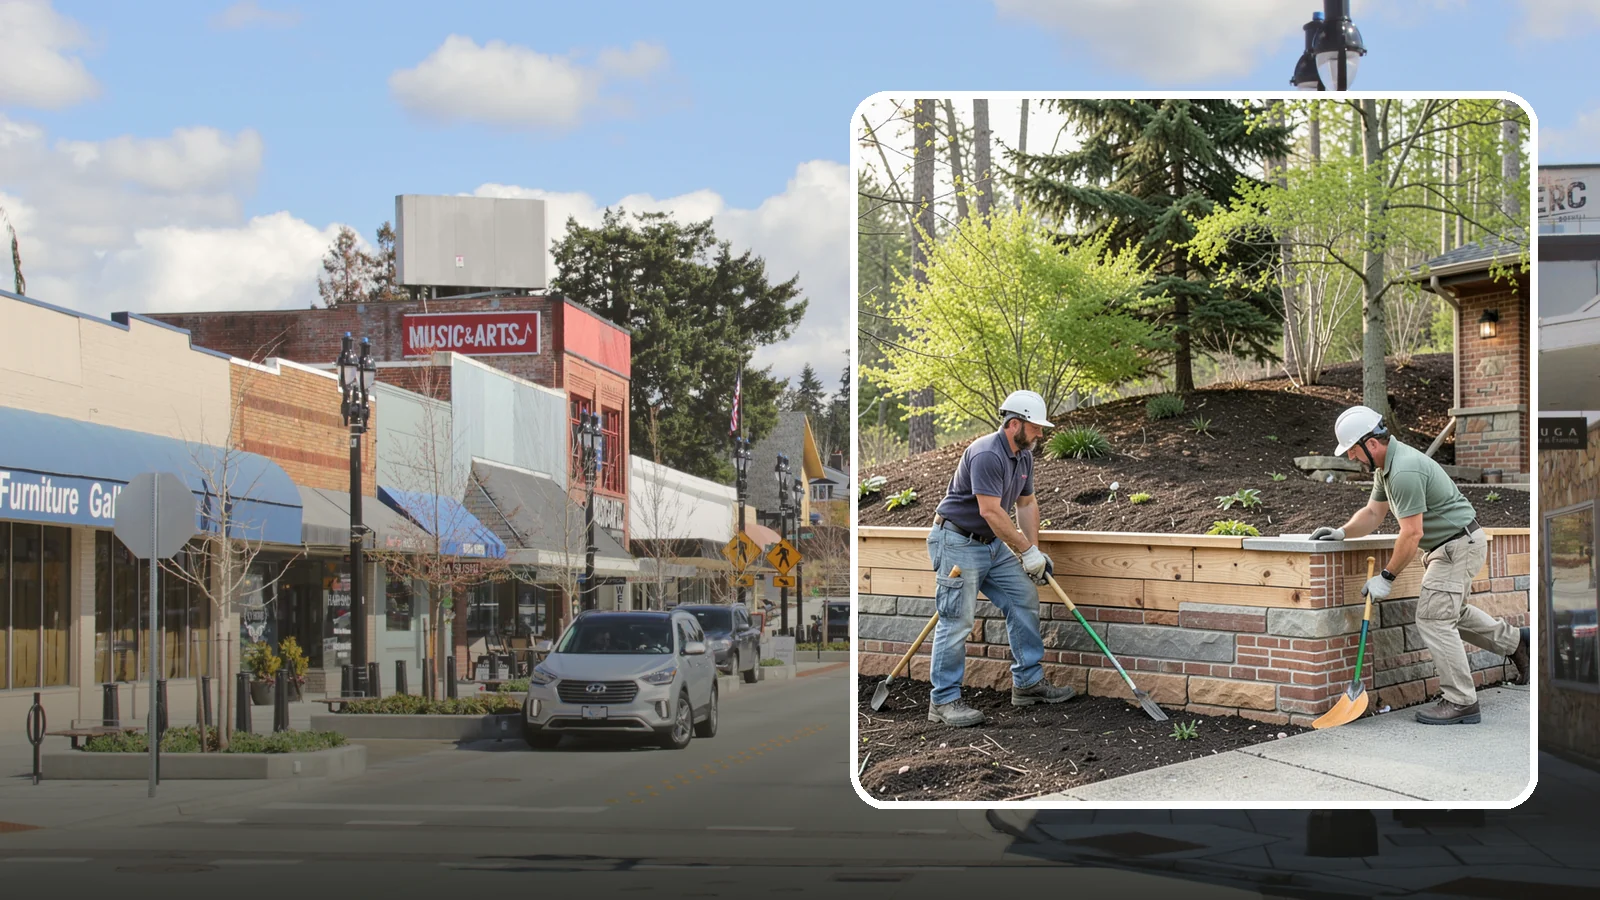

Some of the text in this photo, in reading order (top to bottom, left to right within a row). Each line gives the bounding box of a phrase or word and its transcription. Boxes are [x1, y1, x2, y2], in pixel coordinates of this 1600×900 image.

[408, 322, 520, 349] MUSIC&ARTS
[0, 471, 122, 519] Furniture Gal
